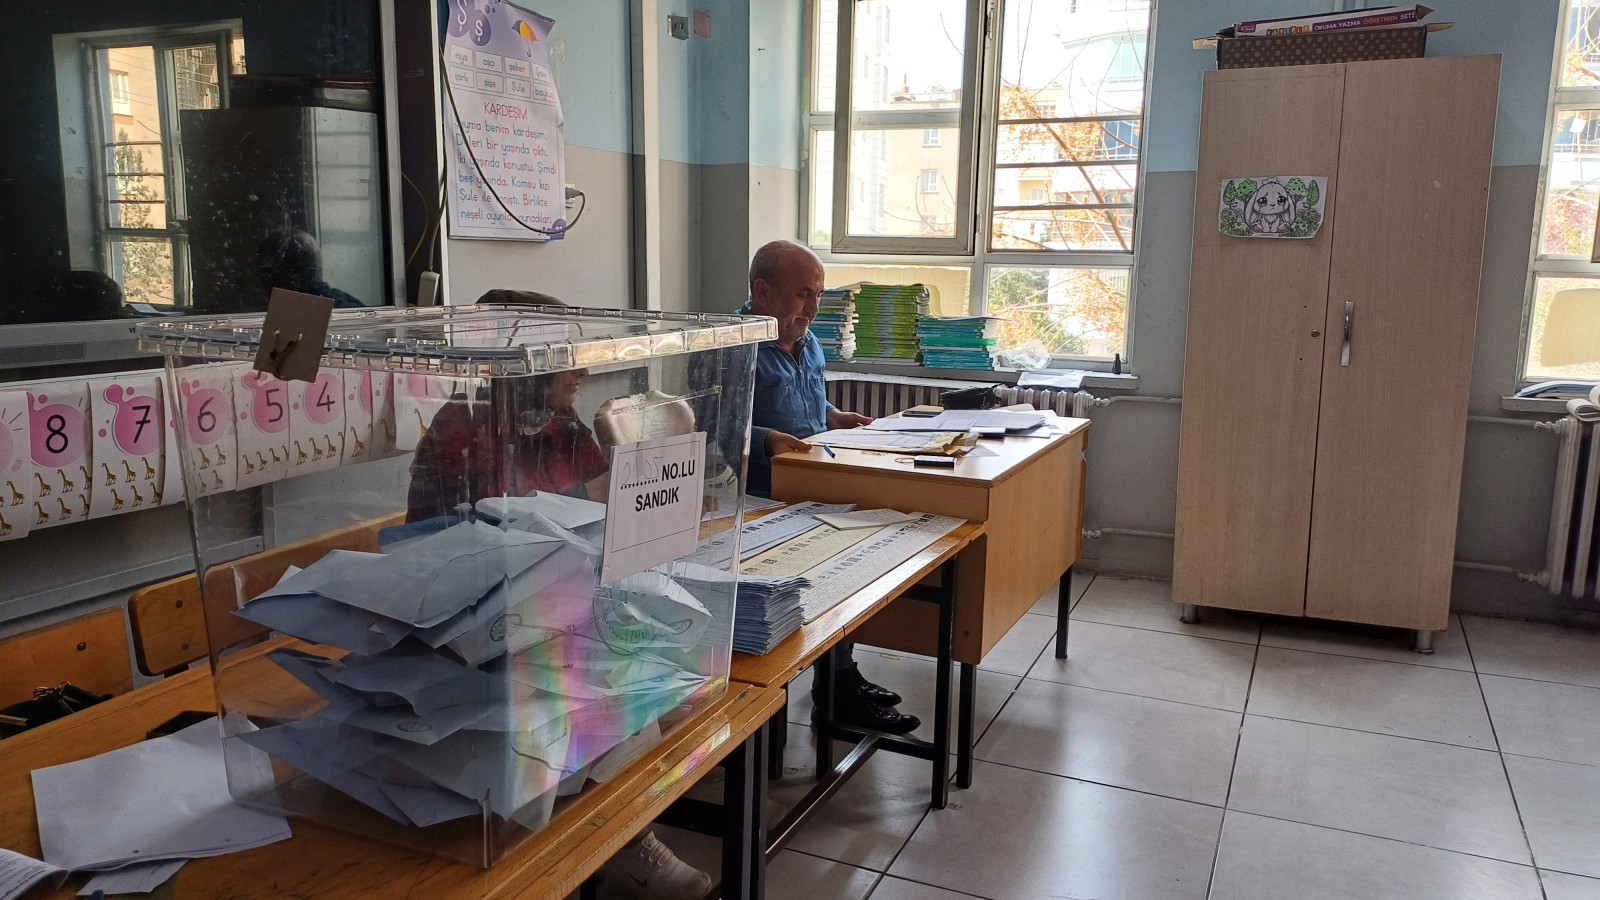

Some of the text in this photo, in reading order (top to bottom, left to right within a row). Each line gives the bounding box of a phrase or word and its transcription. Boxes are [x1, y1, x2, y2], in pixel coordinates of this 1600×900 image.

[1314, 23, 1337, 31] OKUMA
[1338, 20, 1361, 28] YAZMA
[483, 102, 528, 121] KARDEŞİM
[485, 119, 510, 135] benim
[512, 121, 548, 140] kardeşim.
[486, 137, 499, 150] bir
[501, 141, 530, 156] yaşında
[503, 157, 535, 173] konuştu.
[537, 161, 557, 176] Şimdi
[458, 170, 474, 185] beş
[511, 175, 536, 191] Komşu
[459, 188, 478, 204] Şule
[522, 193, 548, 207] Birlikte
[460, 207, 484, 221] neşeli
[265, 388, 284, 423] 5
[316, 381, 336, 413] 4
[132, 405, 151, 444] 7
[197, 396, 217, 433] 6
[45, 414, 69, 454] 8
[661, 459, 696, 482] NO.LU
[635, 487, 680, 512] SANDIK
